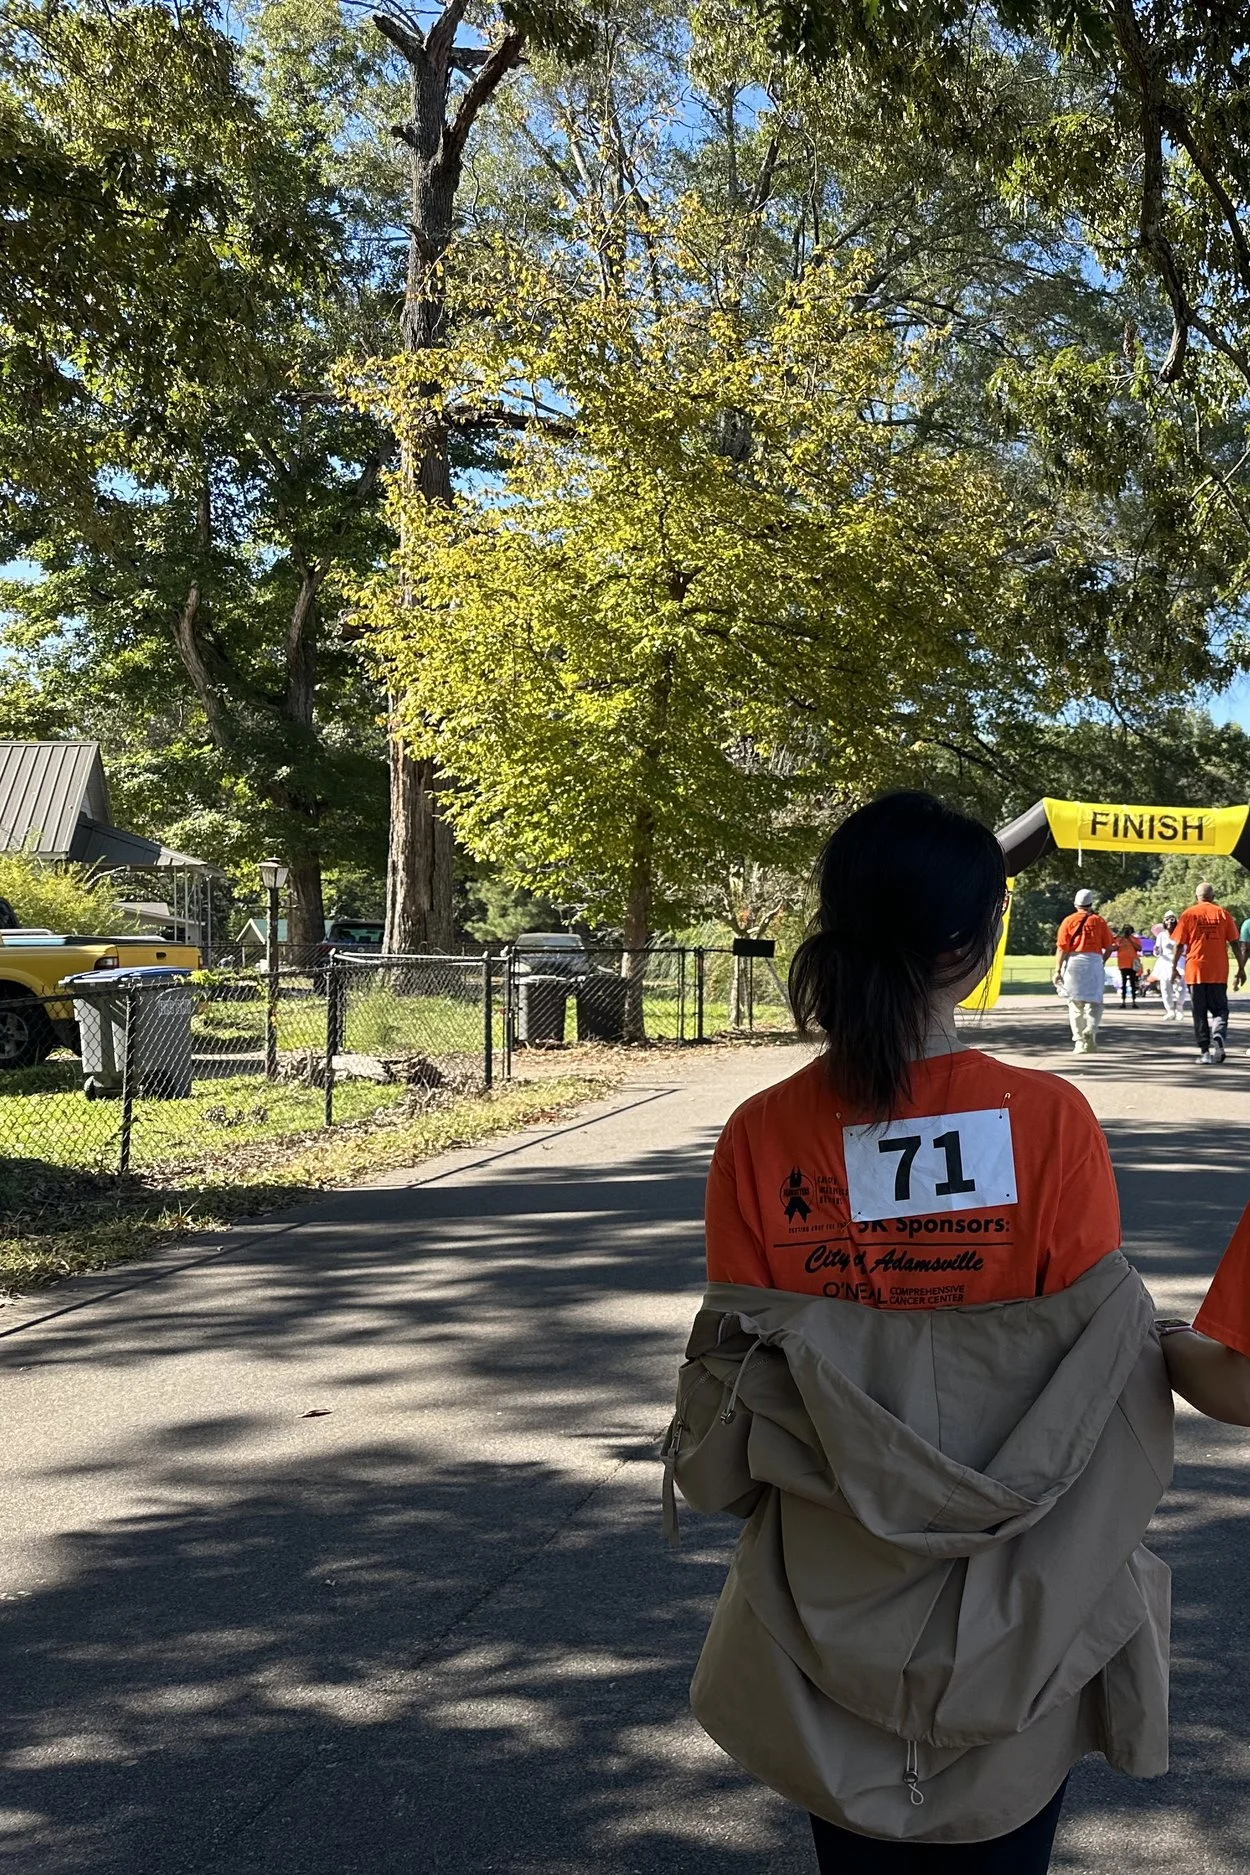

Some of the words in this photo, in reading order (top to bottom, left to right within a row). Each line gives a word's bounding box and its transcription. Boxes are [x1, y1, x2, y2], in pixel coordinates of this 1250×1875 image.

[1090, 811, 1204, 842] FINISH
[877, 1130, 977, 1202] 71
[895, 1217, 1010, 1239] Sponsors:
[804, 1244, 852, 1274] City
[869, 1248, 985, 1274] Adamsville
[889, 1284, 965, 1296] COMPREHENSIVE
[889, 1294, 926, 1305] CANCER
[927, 1293, 964, 1304] CENTER
